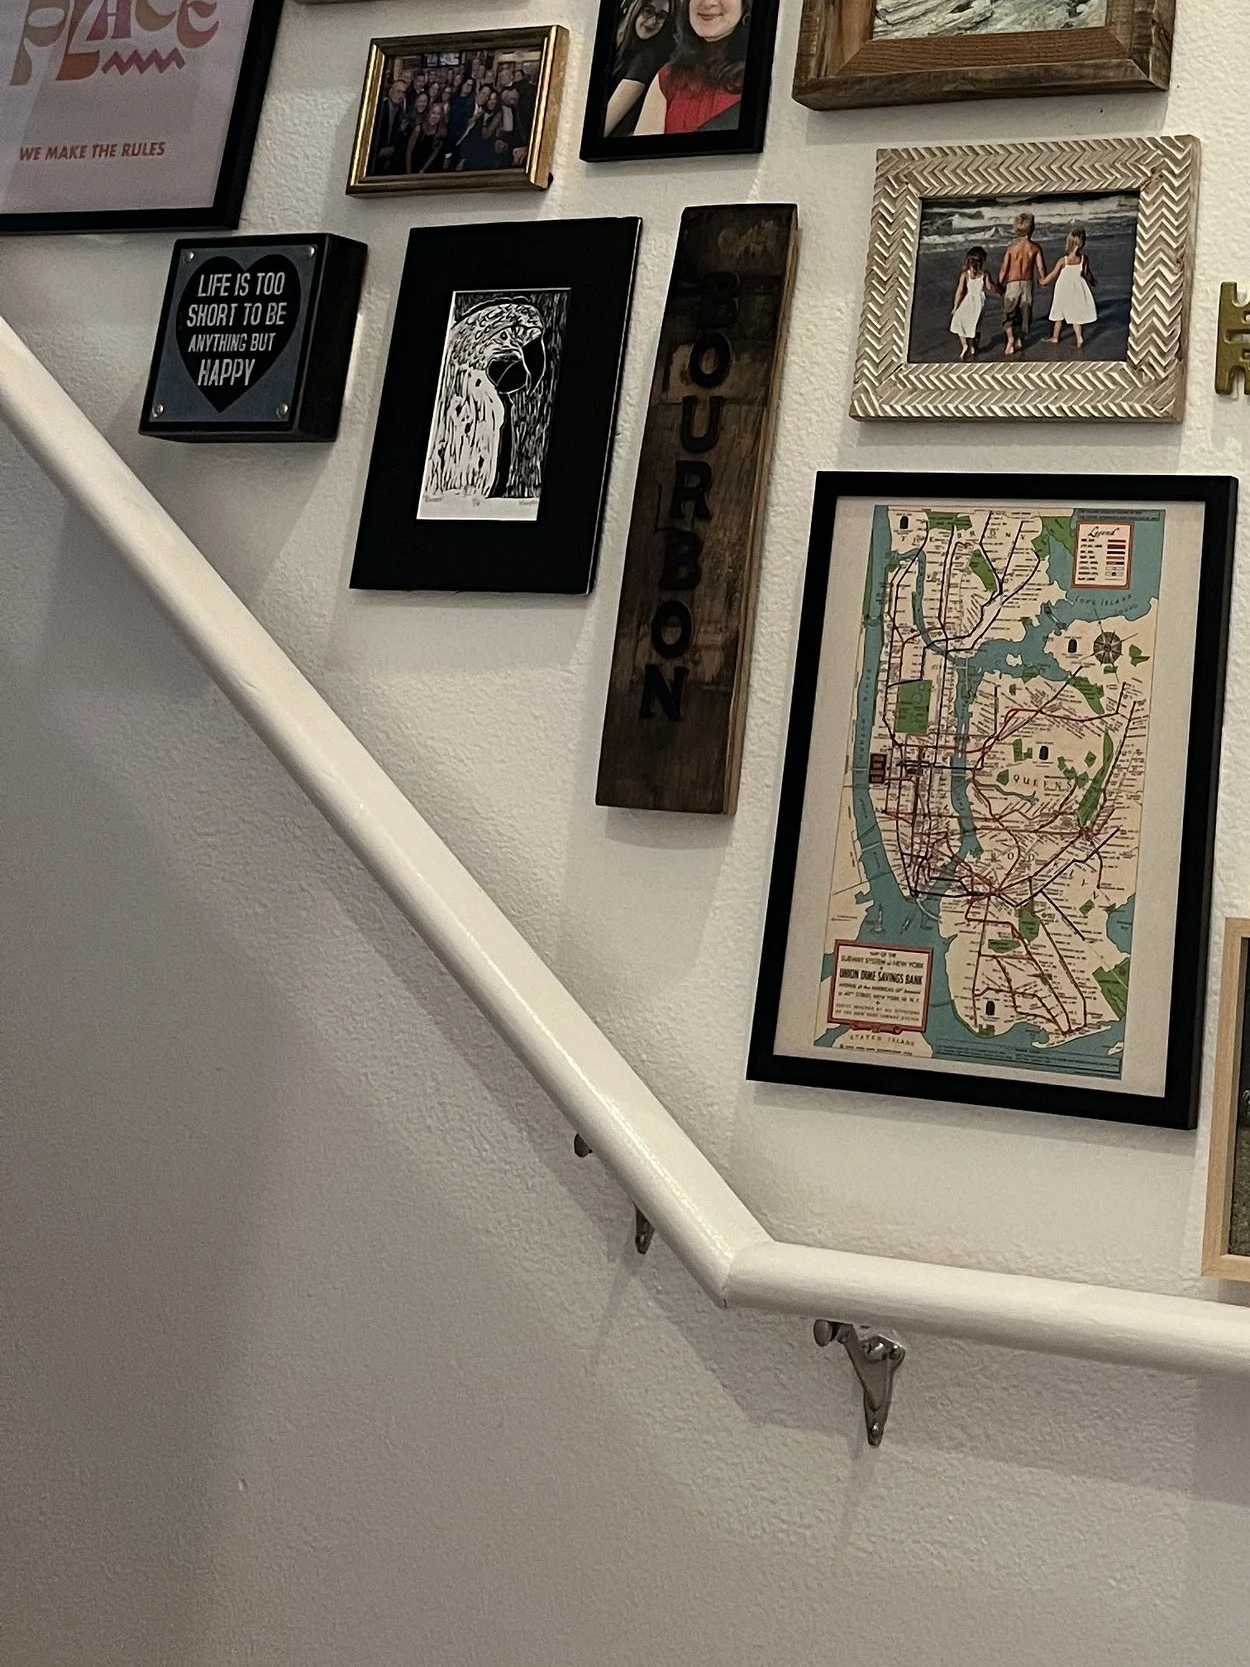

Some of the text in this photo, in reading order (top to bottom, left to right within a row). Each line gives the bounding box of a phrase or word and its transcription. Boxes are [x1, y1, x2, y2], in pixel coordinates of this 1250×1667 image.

[19, 141, 166, 161] WE MAKE THE RULES
[197, 271, 285, 297] LIFE IS TOO
[186, 302, 287, 327] SHORT TO BE
[187, 332, 276, 353] ANYTHING BUT
[197, 358, 255, 386] HAPPY
[638, 270, 741, 722] BOURBON
[905, 974, 924, 986] BANK
